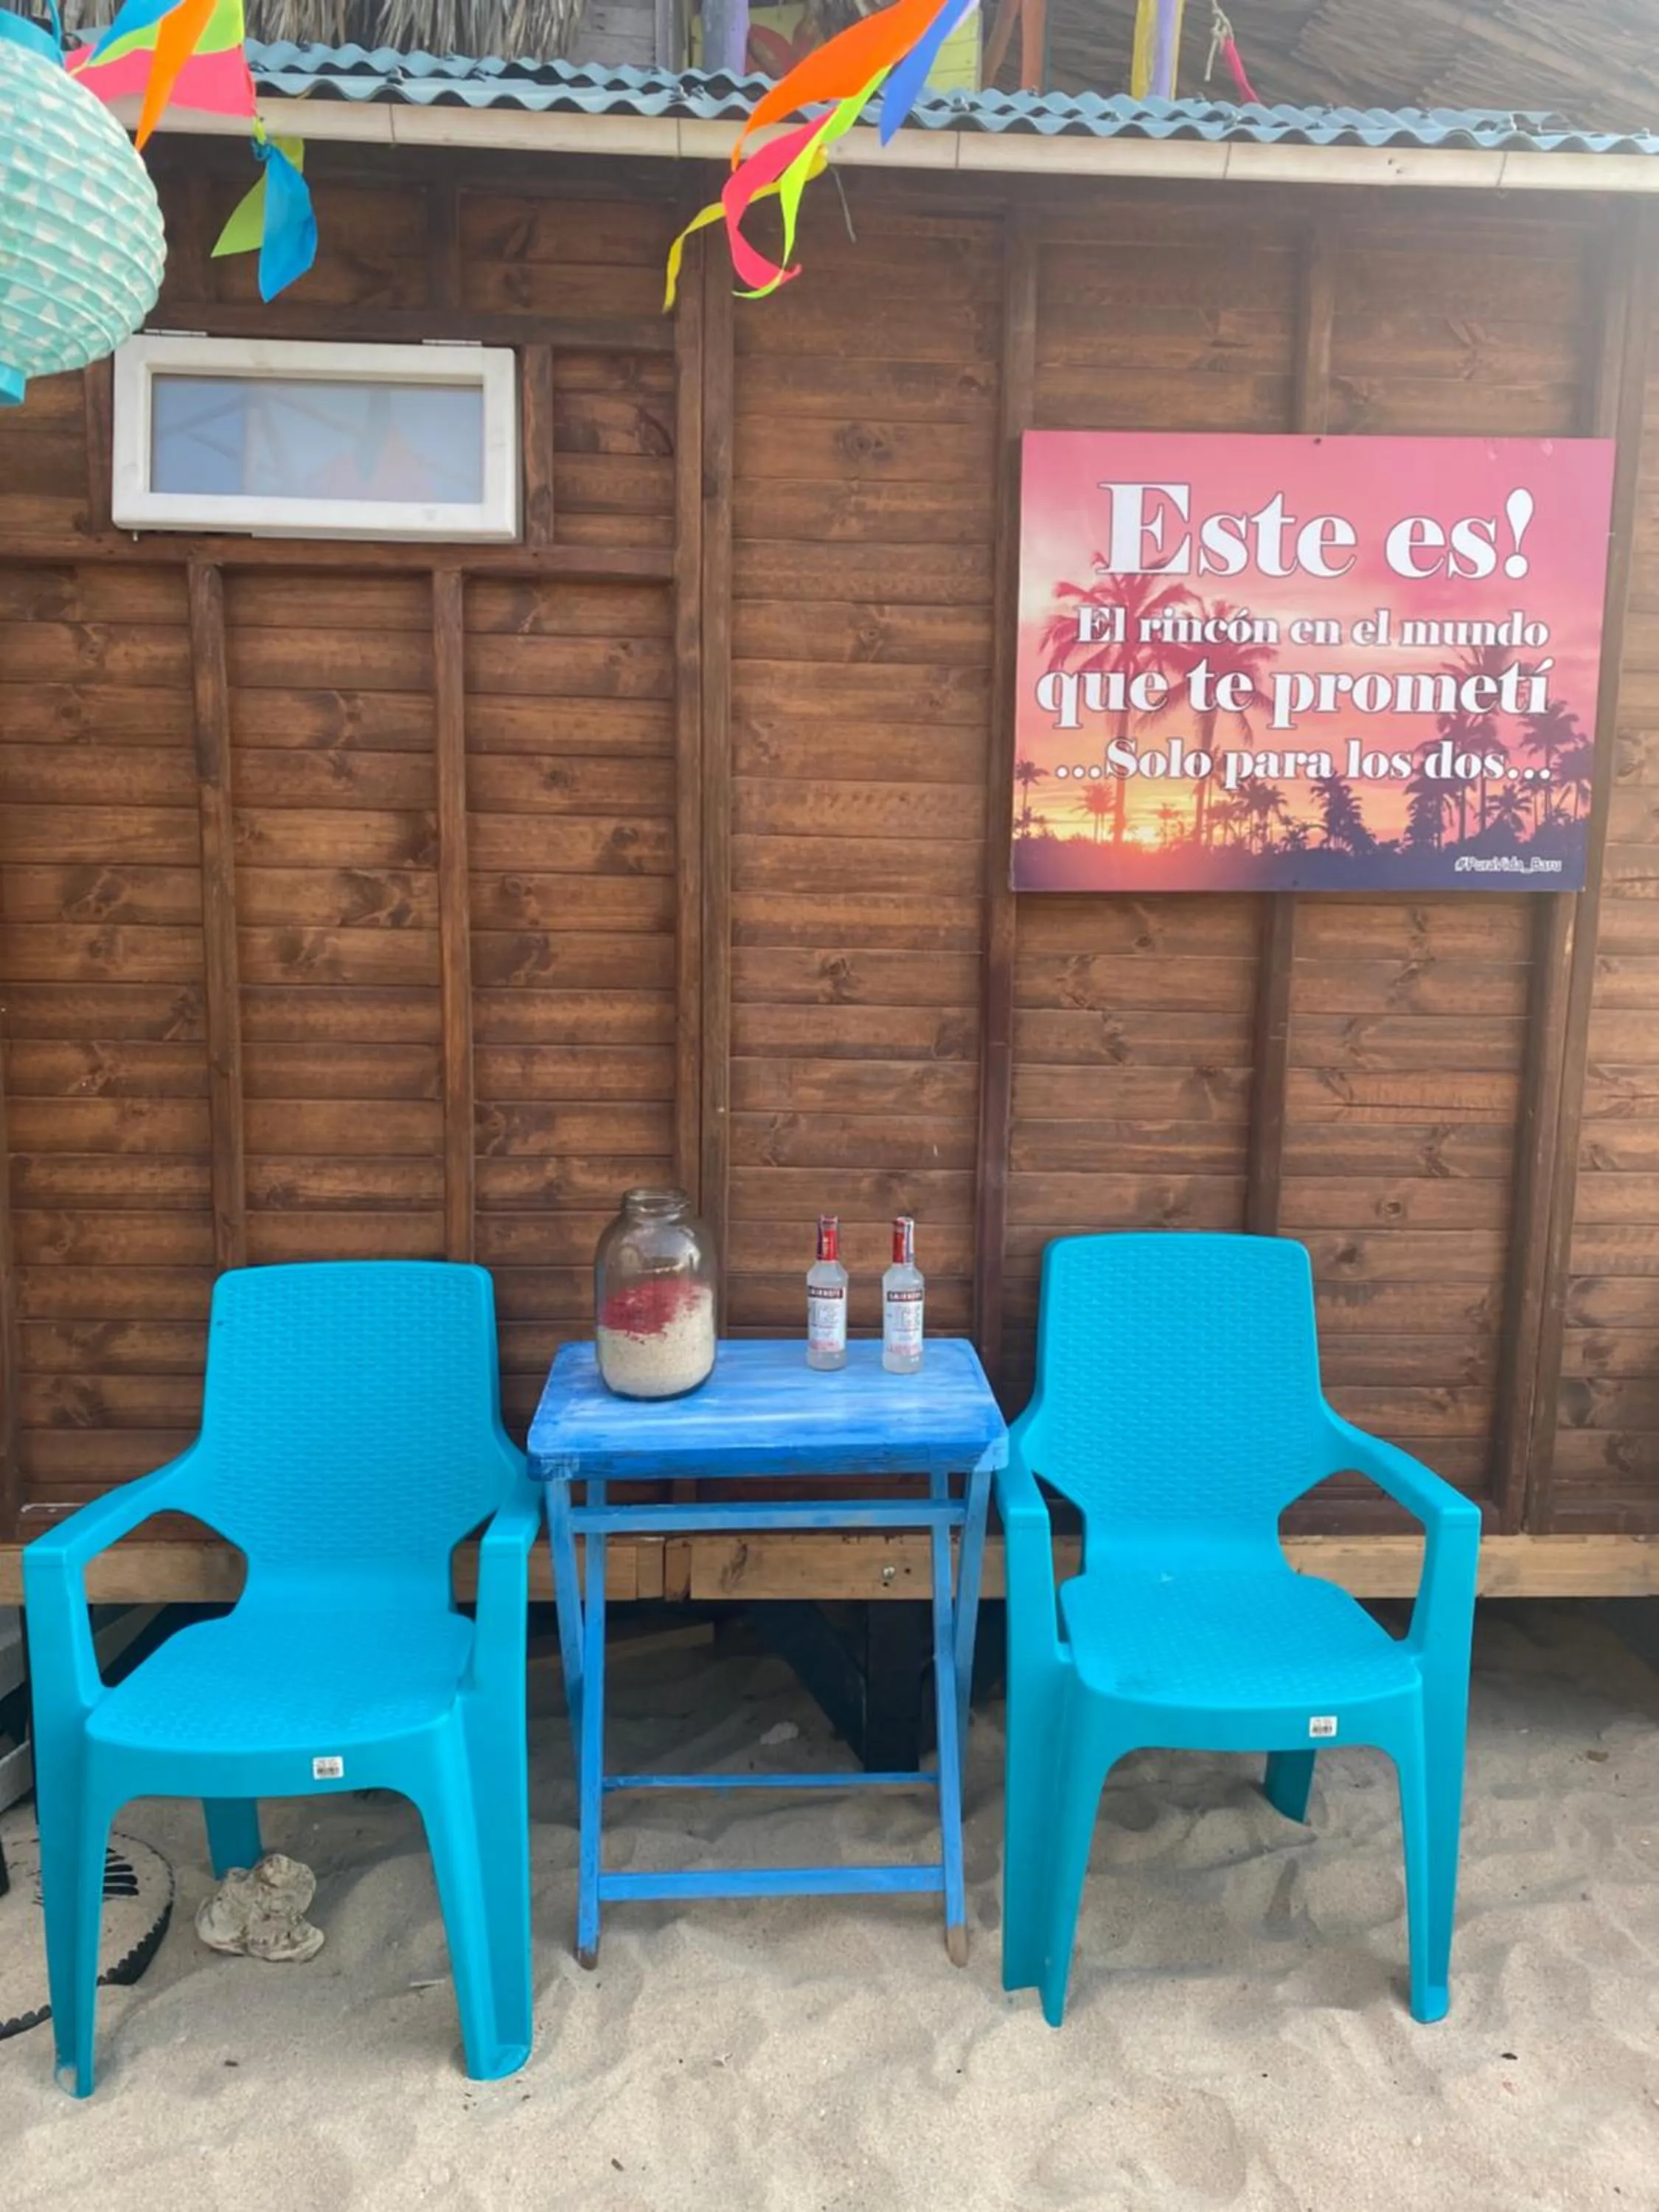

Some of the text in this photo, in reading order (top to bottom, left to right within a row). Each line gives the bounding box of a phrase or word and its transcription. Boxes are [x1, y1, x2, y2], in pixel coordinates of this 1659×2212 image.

[1096, 481, 1534, 580] Este es!
[1076, 605, 1550, 647] El rincón en el mundo
[1035, 657, 1555, 731] que te prometí
[1222, 748, 1333, 791] para
[1345, 738, 1413, 780] los
[1424, 739, 1551, 781] dos...
